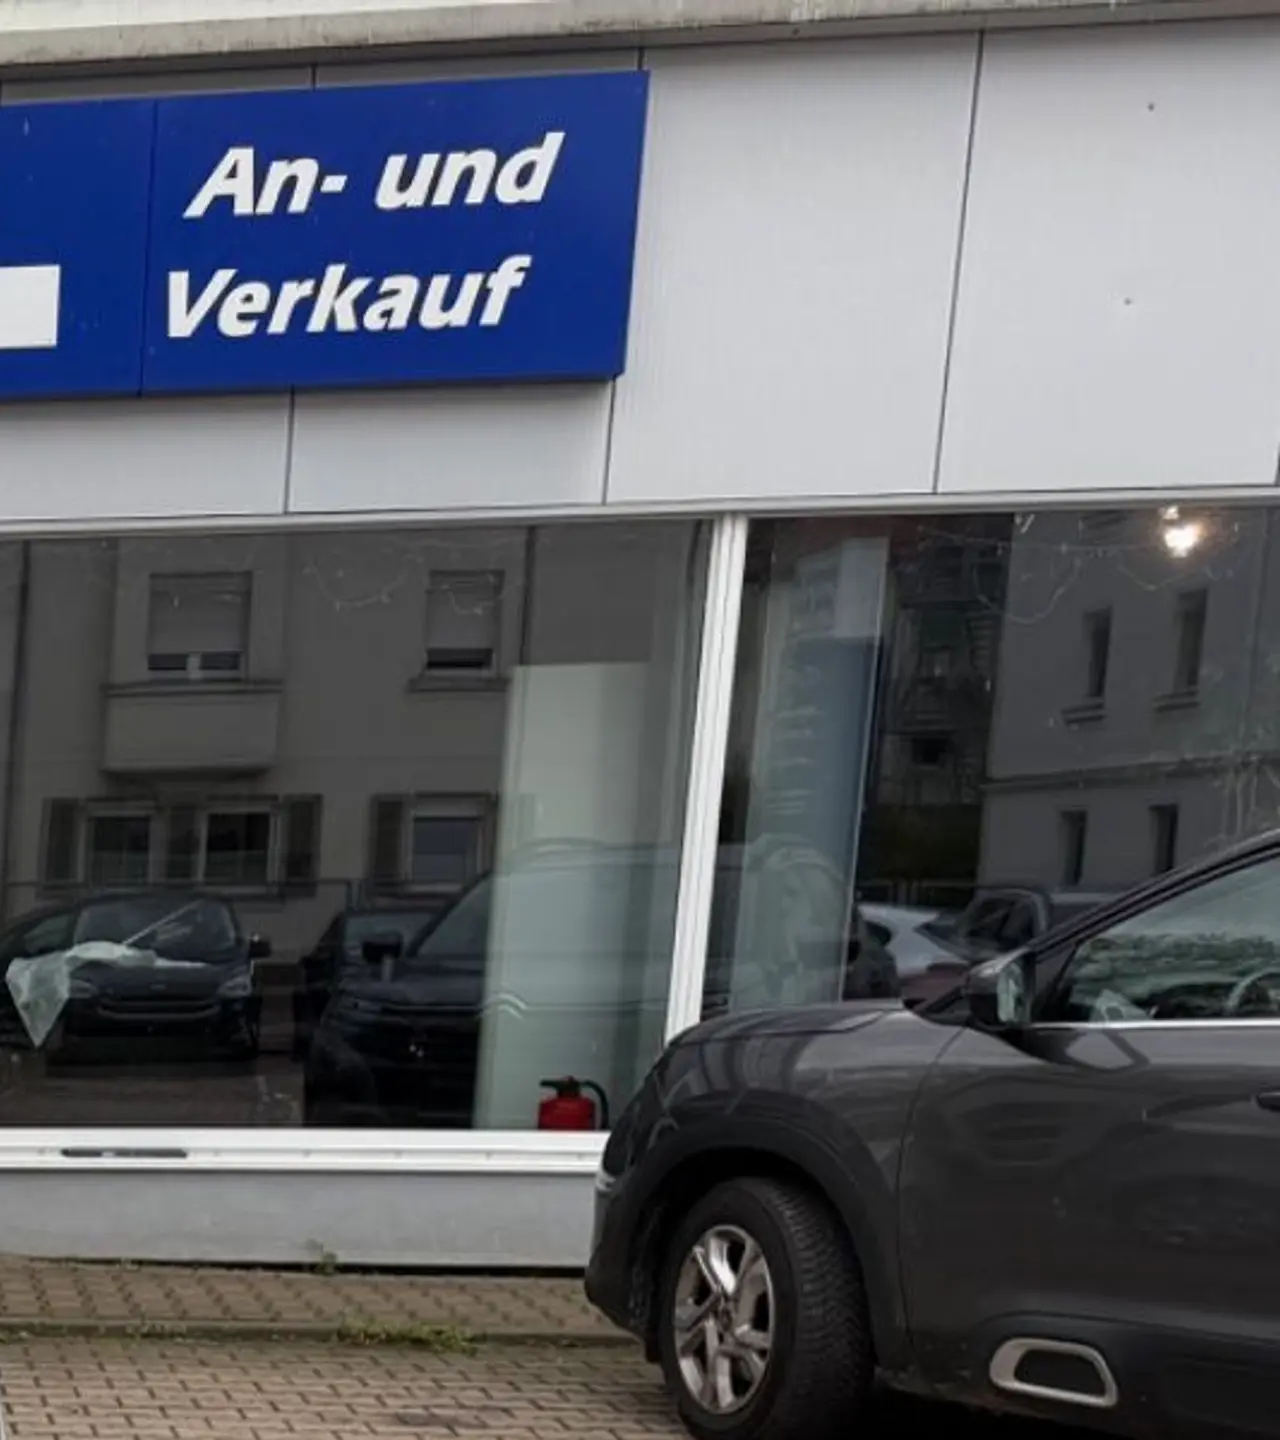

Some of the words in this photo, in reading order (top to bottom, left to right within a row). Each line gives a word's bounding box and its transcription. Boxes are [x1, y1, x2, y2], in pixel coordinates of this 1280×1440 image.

[183, 147, 348, 218] An-
[375, 131, 566, 210] und
[168, 254, 532, 338] Verkauf
